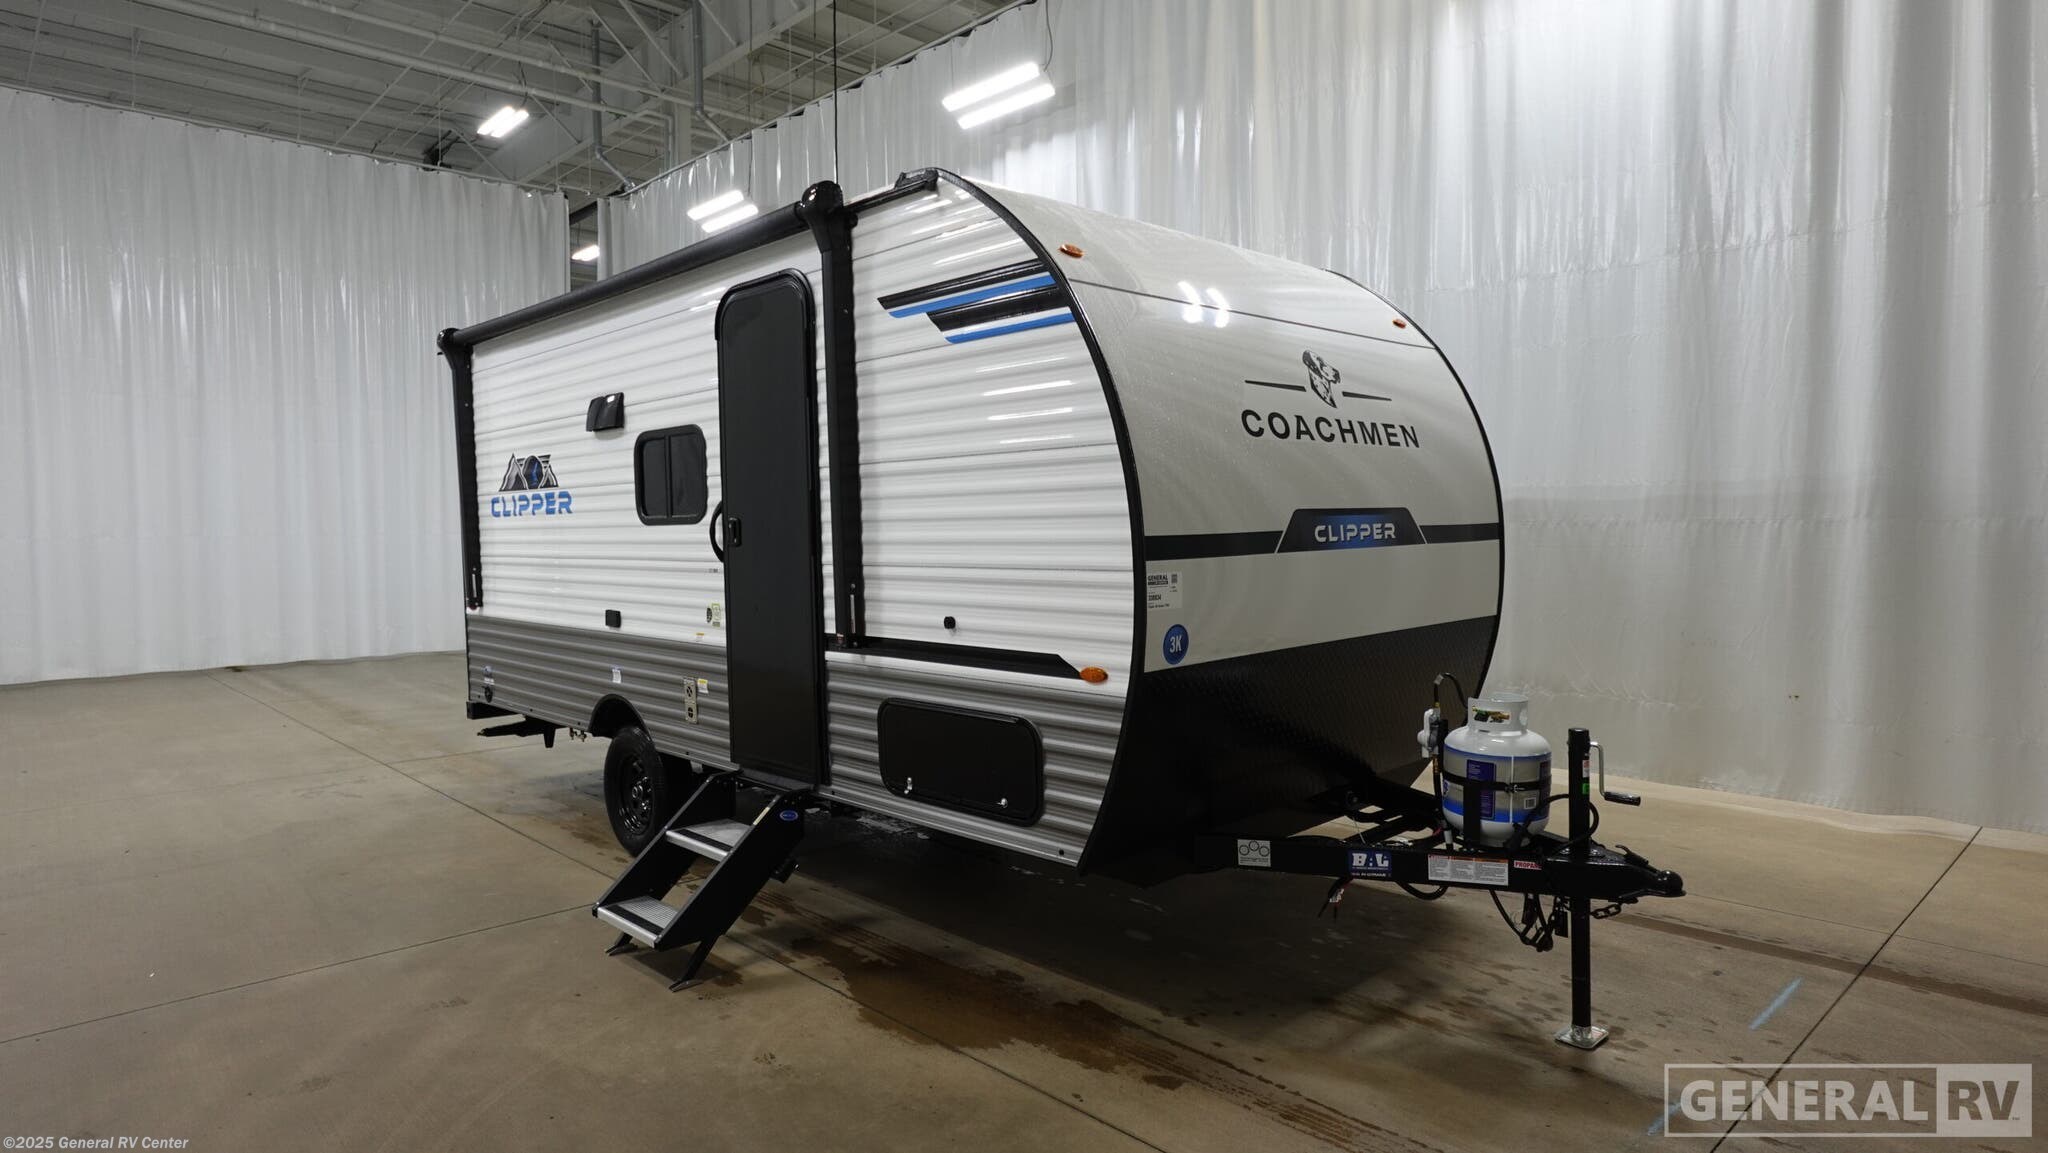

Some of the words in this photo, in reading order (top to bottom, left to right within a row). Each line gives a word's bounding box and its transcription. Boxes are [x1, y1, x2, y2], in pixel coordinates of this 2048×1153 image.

[1241, 409, 1420, 449] COACHMEN
[491, 491, 573, 518] CLIPPER
[1314, 522, 1396, 543] CLIPPER
[1169, 635, 1182, 653] 3K
